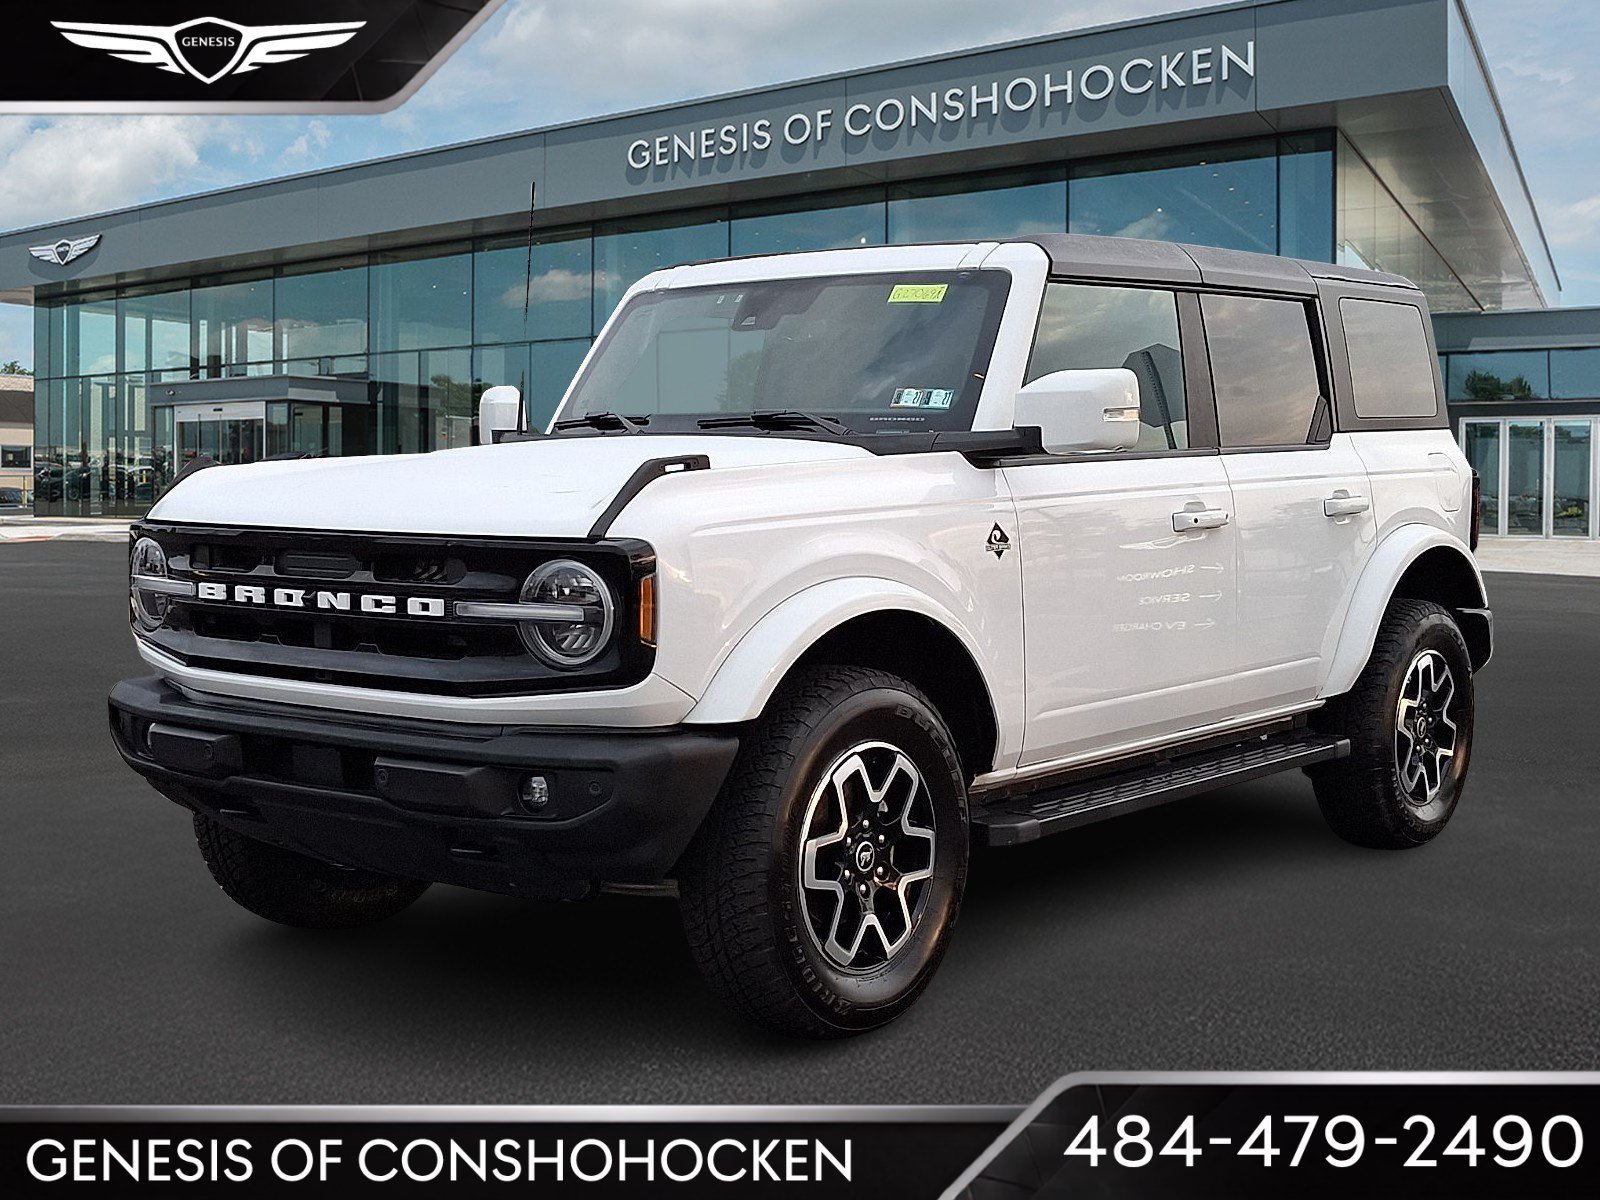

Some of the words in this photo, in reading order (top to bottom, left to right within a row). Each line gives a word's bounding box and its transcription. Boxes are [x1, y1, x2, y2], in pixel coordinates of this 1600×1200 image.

[627, 118, 772, 169] GENESIS
[783, 110, 833, 147] OF
[845, 41, 1254, 136] CONSHOHOCKEN
[198, 582, 445, 617] BRONCO
